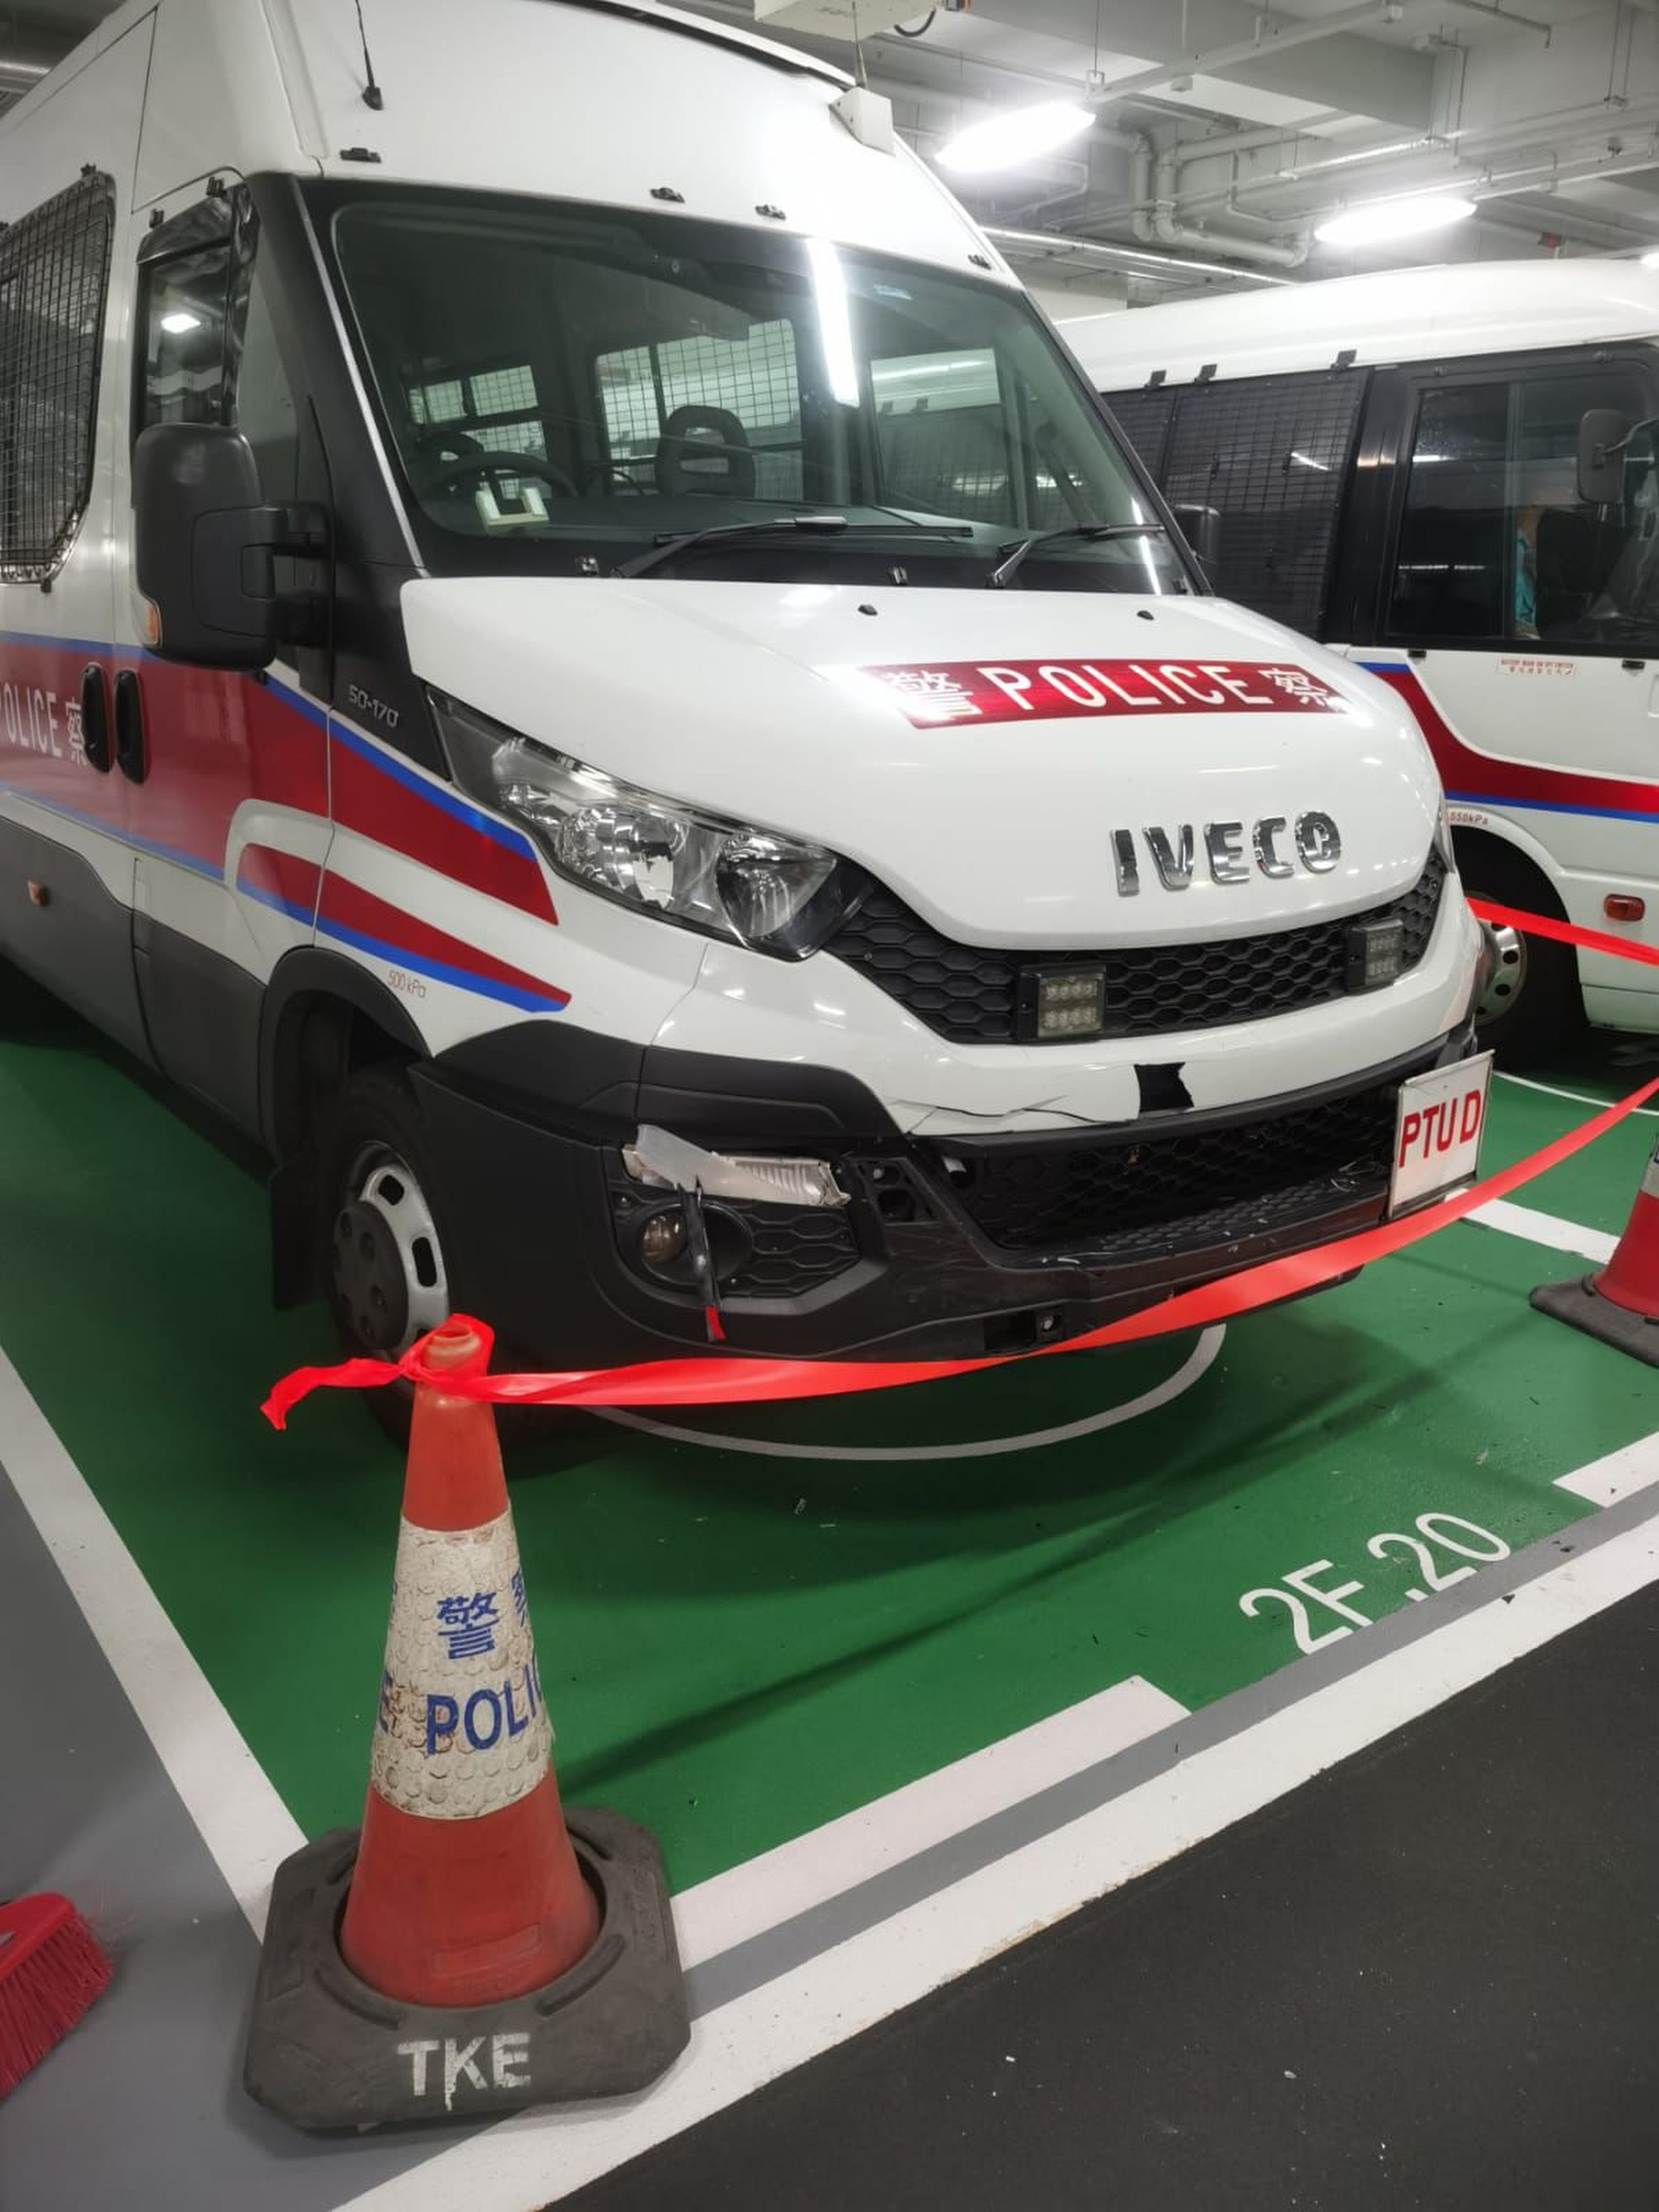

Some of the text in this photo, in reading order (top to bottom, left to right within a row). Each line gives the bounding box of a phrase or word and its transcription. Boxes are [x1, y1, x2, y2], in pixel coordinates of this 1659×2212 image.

[0, 682, 63, 757] OLICE
[880, 665, 1349, 720] 警 POLICE 察
[1110, 812, 1341, 897] IVECO
[436, 1592, 500, 1660] 警
[426, 1654, 542, 1755] POLI
[398, 2032, 531, 2101] TKE
